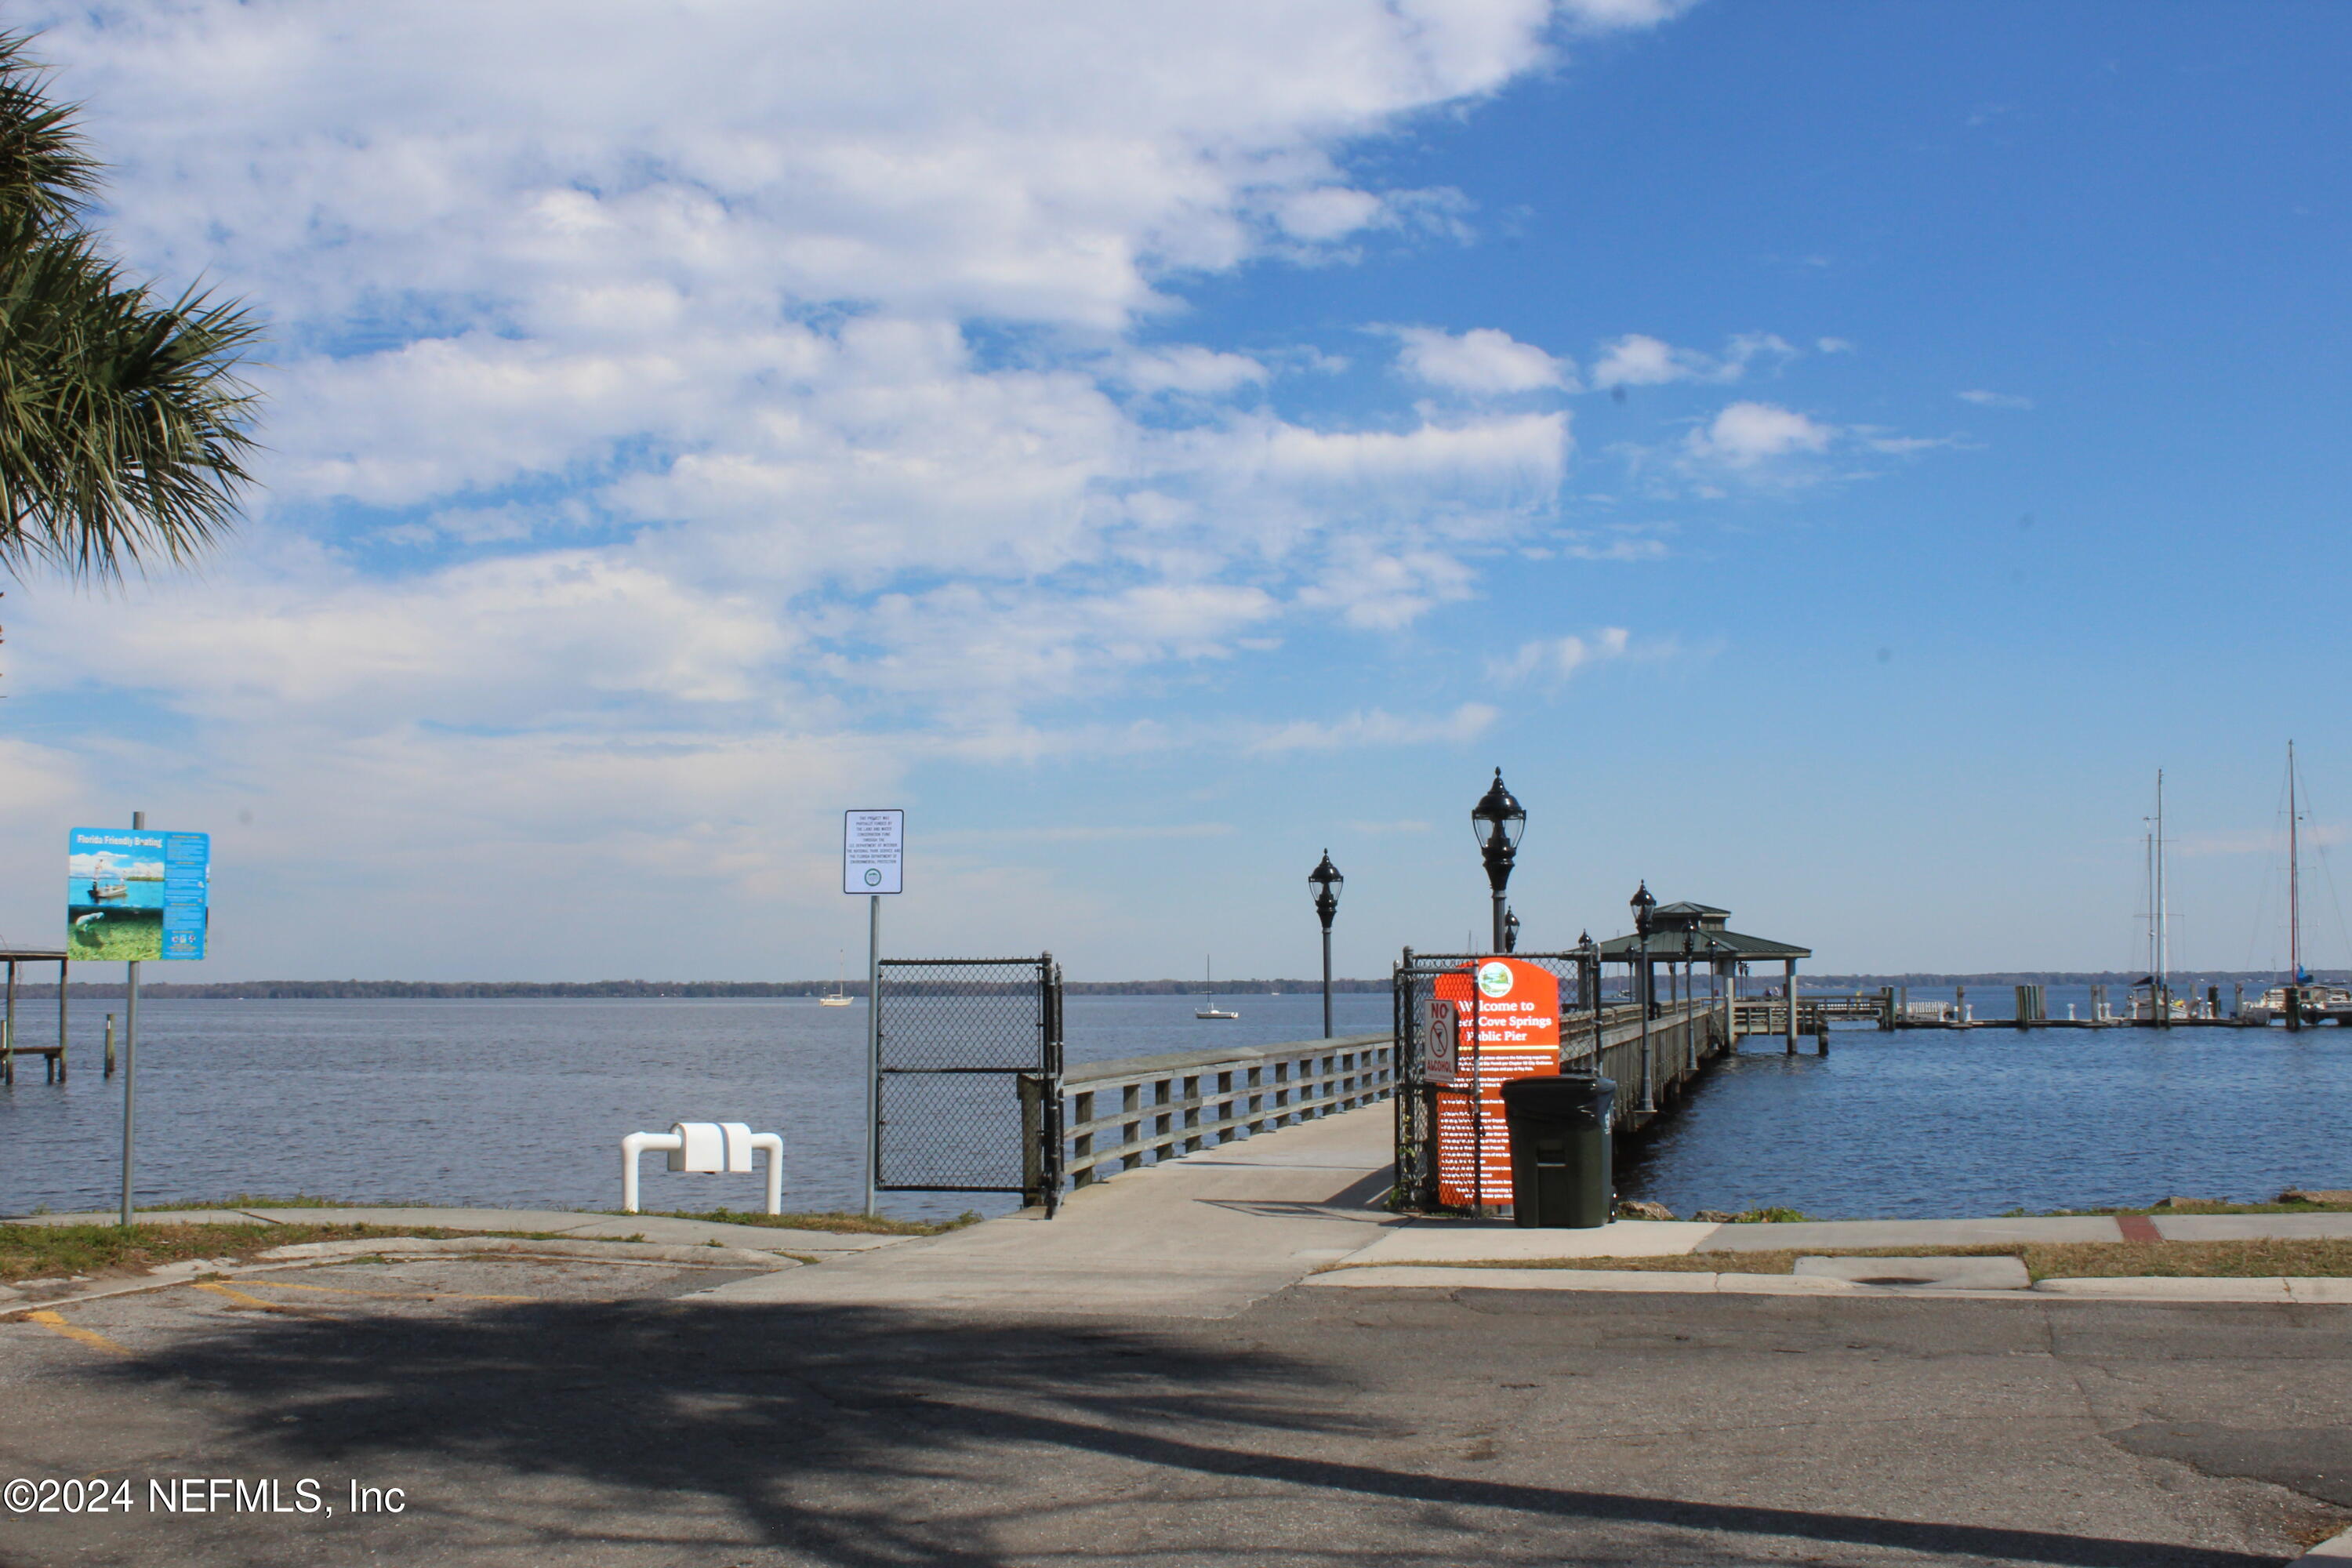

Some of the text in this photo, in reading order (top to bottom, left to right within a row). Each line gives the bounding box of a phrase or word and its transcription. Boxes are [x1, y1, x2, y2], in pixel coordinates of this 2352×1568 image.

[77, 834, 103, 844] Florida
[104, 836, 133, 848] Friendly
[1431, 1002, 1449, 1019] NO
[1458, 1000, 1535, 1012] Wlcome to
[1478, 1016, 1507, 1027] Cove
[1508, 1015, 1552, 1029] Springs
[1504, 1030, 1528, 1041] Pier
[1427, 1059, 1452, 1073] ALCOHOL
